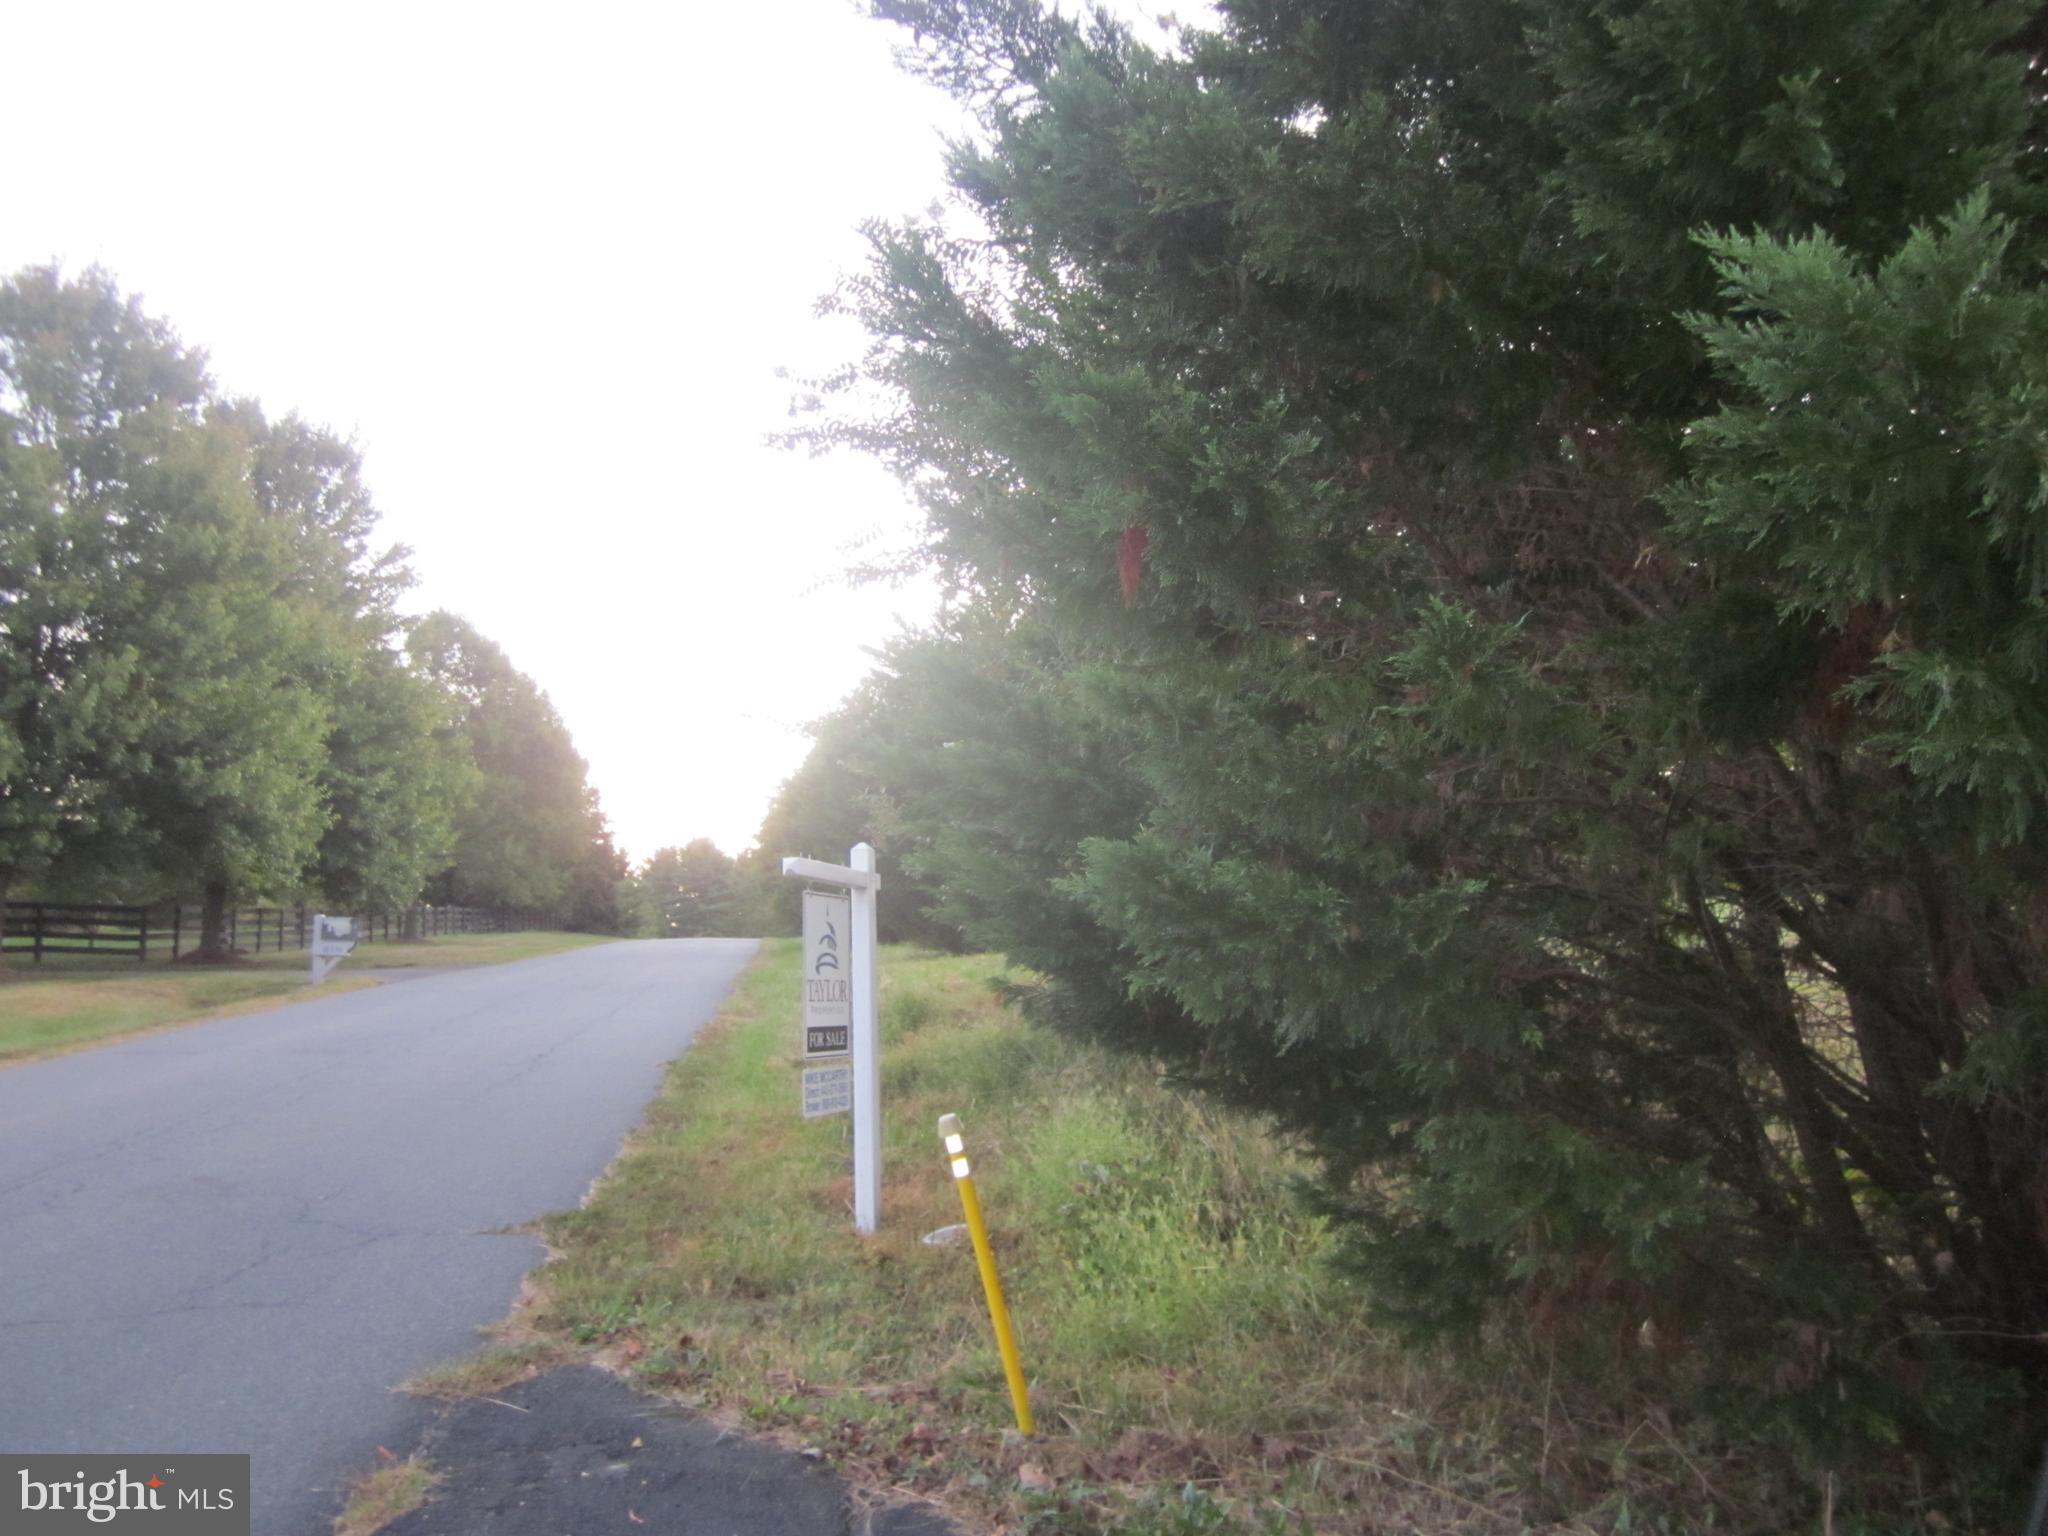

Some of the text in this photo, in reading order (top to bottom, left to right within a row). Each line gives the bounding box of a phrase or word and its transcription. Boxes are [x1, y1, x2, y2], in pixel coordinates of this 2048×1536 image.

[807, 979, 848, 1002] TAYLOR
[808, 1030, 846, 1048] FOR SALE
